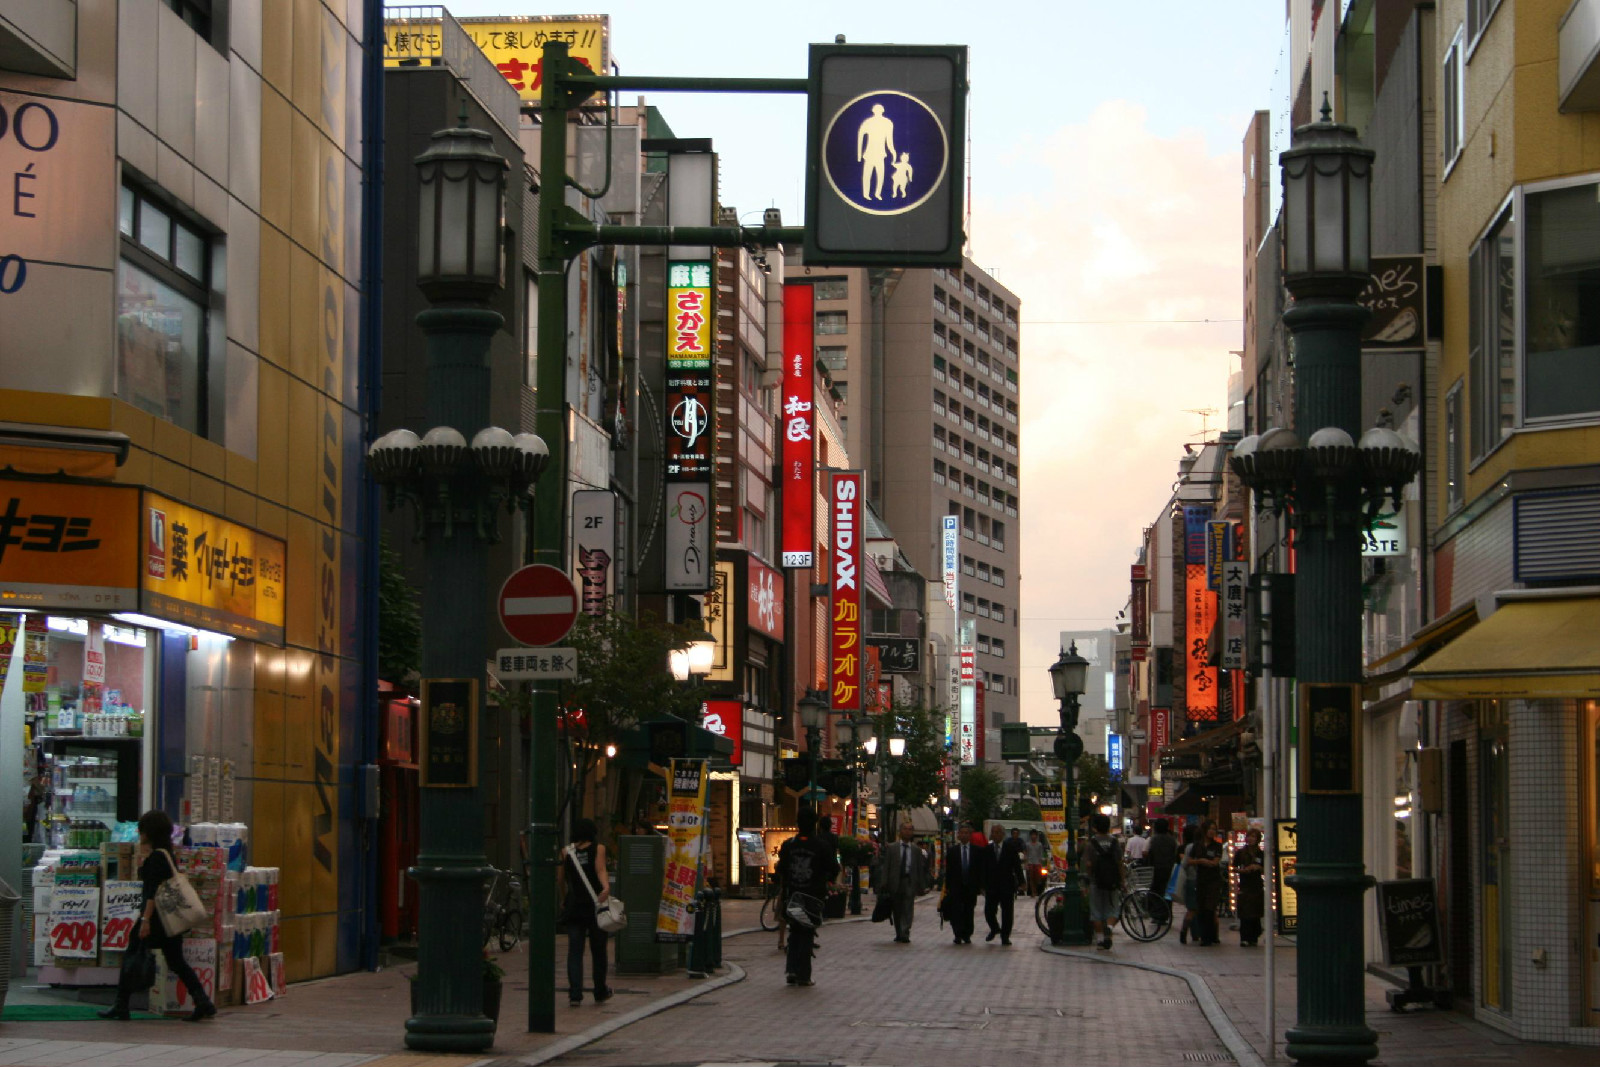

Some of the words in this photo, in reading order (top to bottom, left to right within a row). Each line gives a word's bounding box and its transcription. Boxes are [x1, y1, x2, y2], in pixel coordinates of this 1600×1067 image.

[0, 102, 59, 152] O
[671, 265, 710, 287] 麻雀
[676, 291, 703, 351] さかえ
[784, 396, 811, 442] 和民
[668, 465, 680, 473] 2F
[585, 517, 603, 529] 2F
[836, 480, 856, 590] SHIDAX
[172, 521, 189, 582] 薬
[1227, 567, 1243, 653] 大鹿洋店
[500, 656, 574, 672] 軽車両を除く
[834, 599, 858, 704] カラオケ
[51, 921, 96, 951] 298
